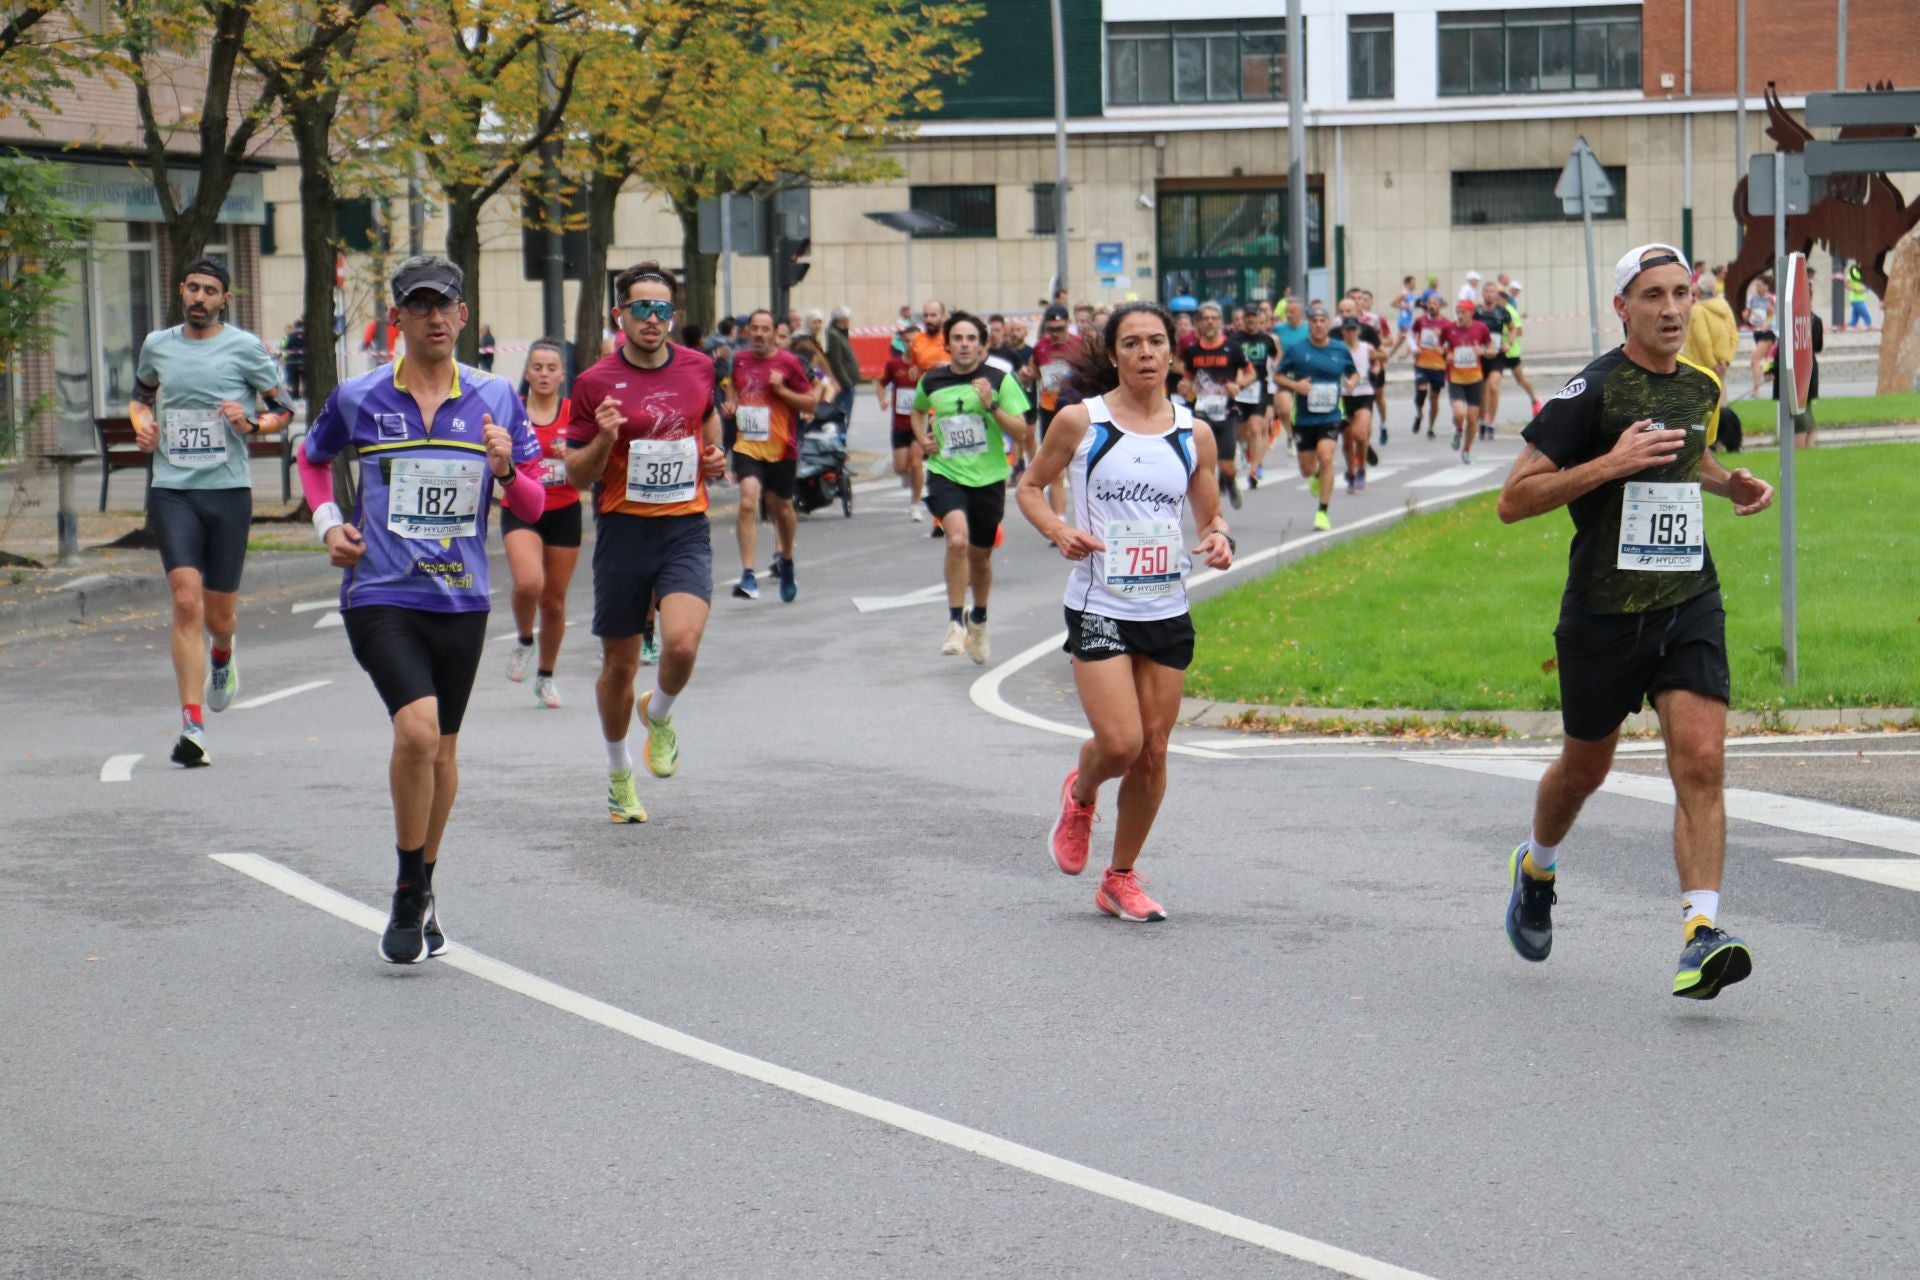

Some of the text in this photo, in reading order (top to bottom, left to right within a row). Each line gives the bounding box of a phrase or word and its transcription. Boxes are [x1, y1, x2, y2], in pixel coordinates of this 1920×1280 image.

[1794, 317, 1812, 350] STOP
[179, 428, 211, 448] 375
[951, 428, 975, 446] 693
[645, 461, 684, 485] 387
[418, 487, 458, 516] 182
[424, 525, 462, 534] HYUNDAI
[1649, 513, 1688, 545] 193
[1125, 546, 1169, 576] 750
[1655, 557, 1692, 565] HYUNDAI
[1137, 583, 1172, 592] HYUNDAI
